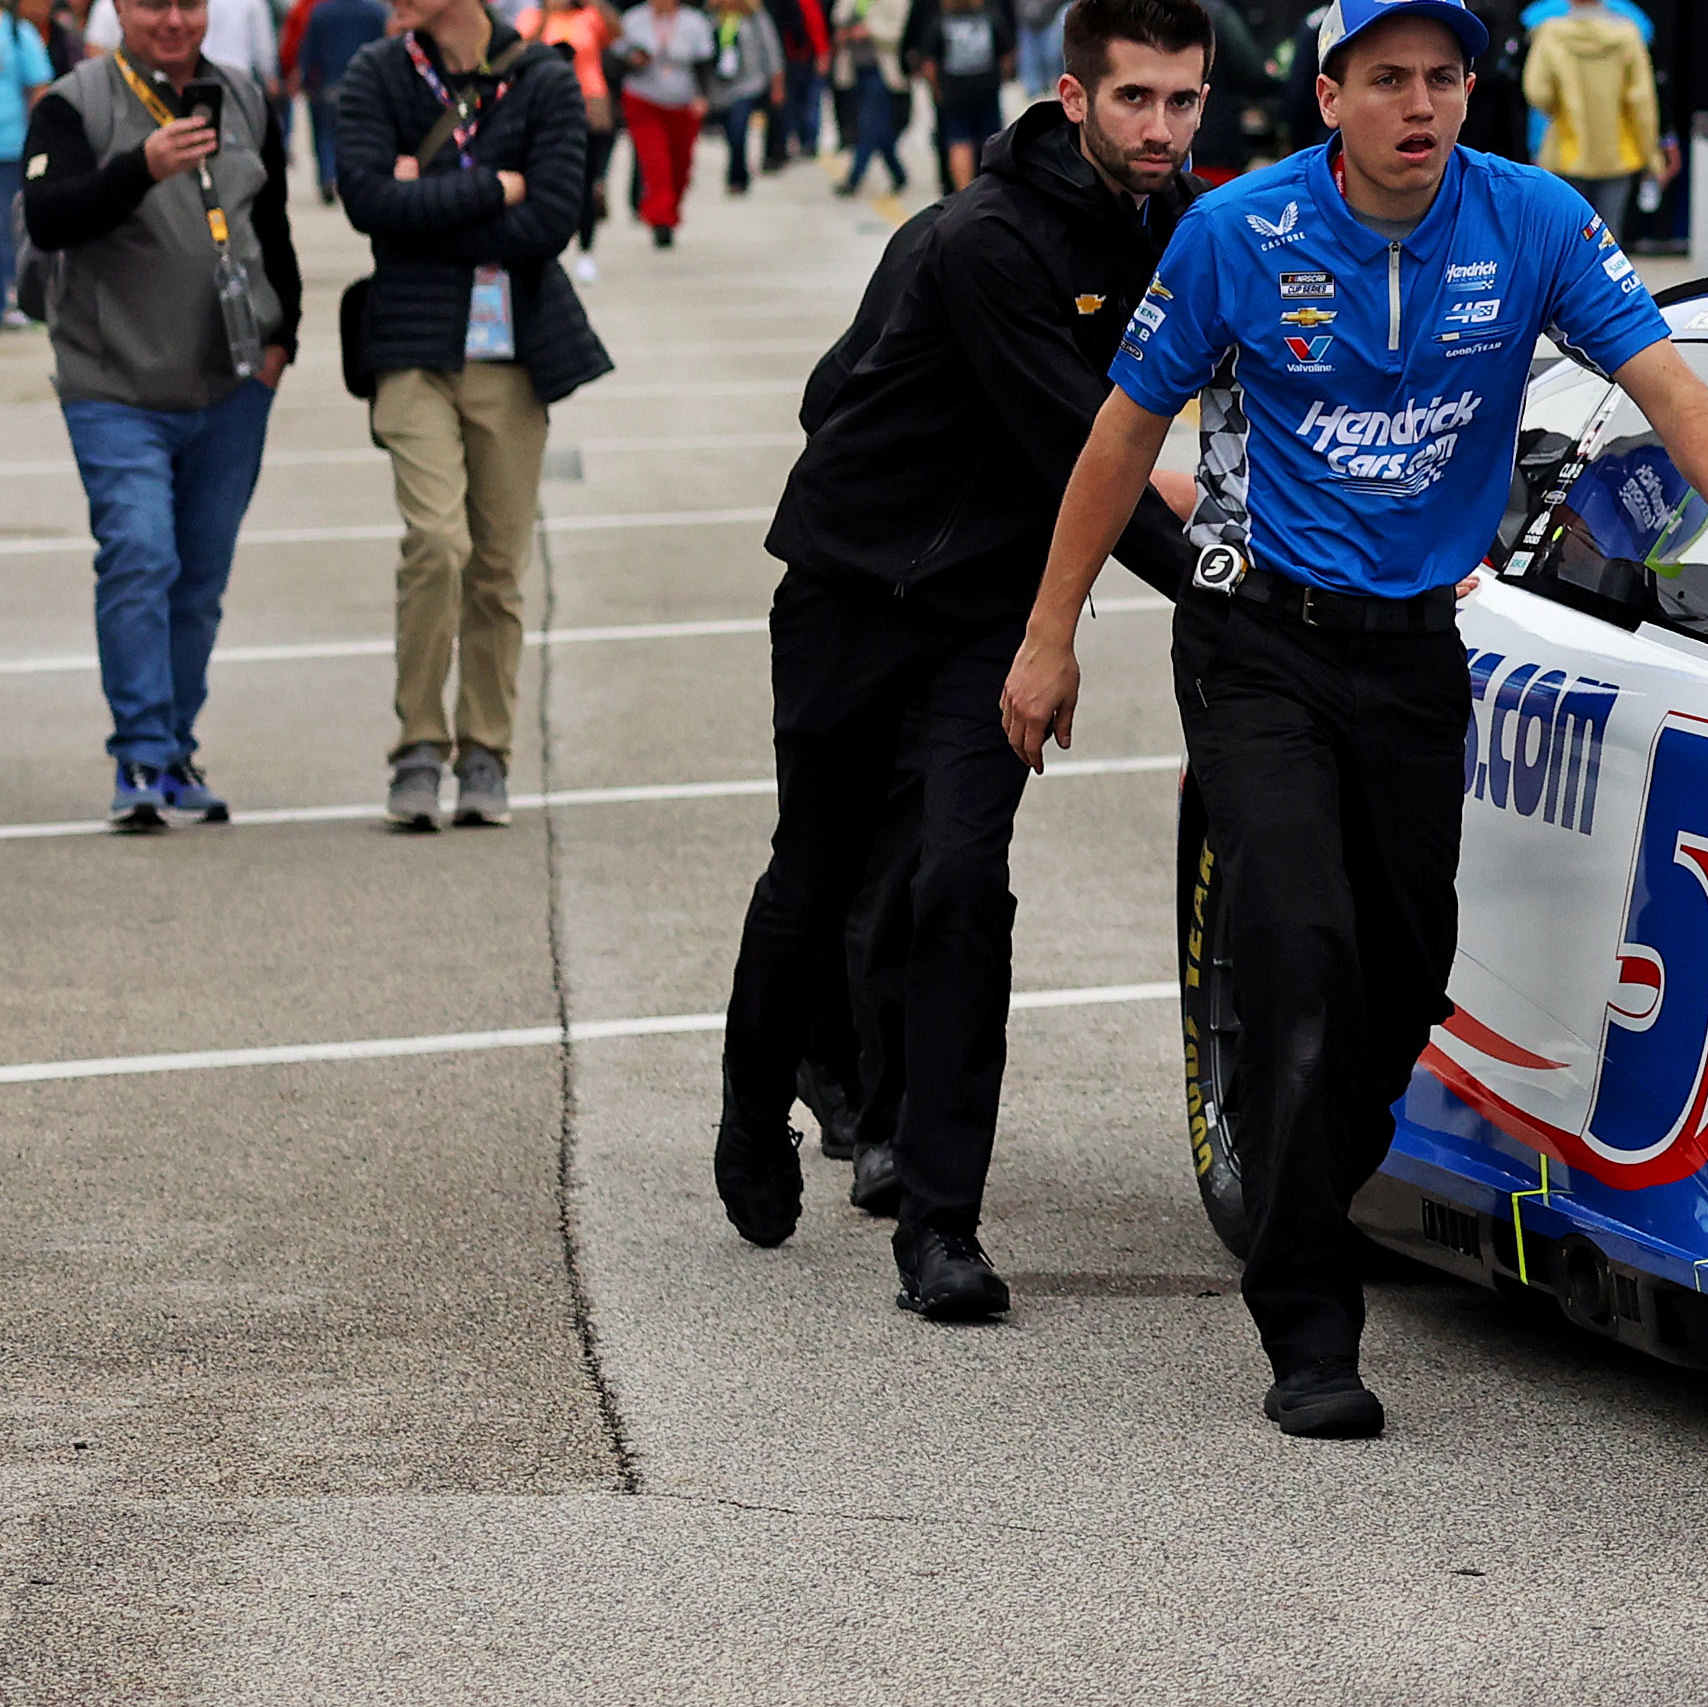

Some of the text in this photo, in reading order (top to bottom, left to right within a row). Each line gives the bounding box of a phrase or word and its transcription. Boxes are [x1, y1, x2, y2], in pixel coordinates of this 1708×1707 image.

[1261, 231, 1306, 252] CASTORE
[1294, 274, 1327, 283] NASCAR
[1445, 260, 1497, 283] Hendrick
[1303, 286, 1327, 294] SERIES
[1445, 342, 1502, 358] GOODYEAR
[1286, 363, 1334, 373] Valvoline
[1296, 390, 1482, 452] Hendrick
[1327, 433, 1458, 480] Cars.com
[1204, 555, 1230, 576] 5
